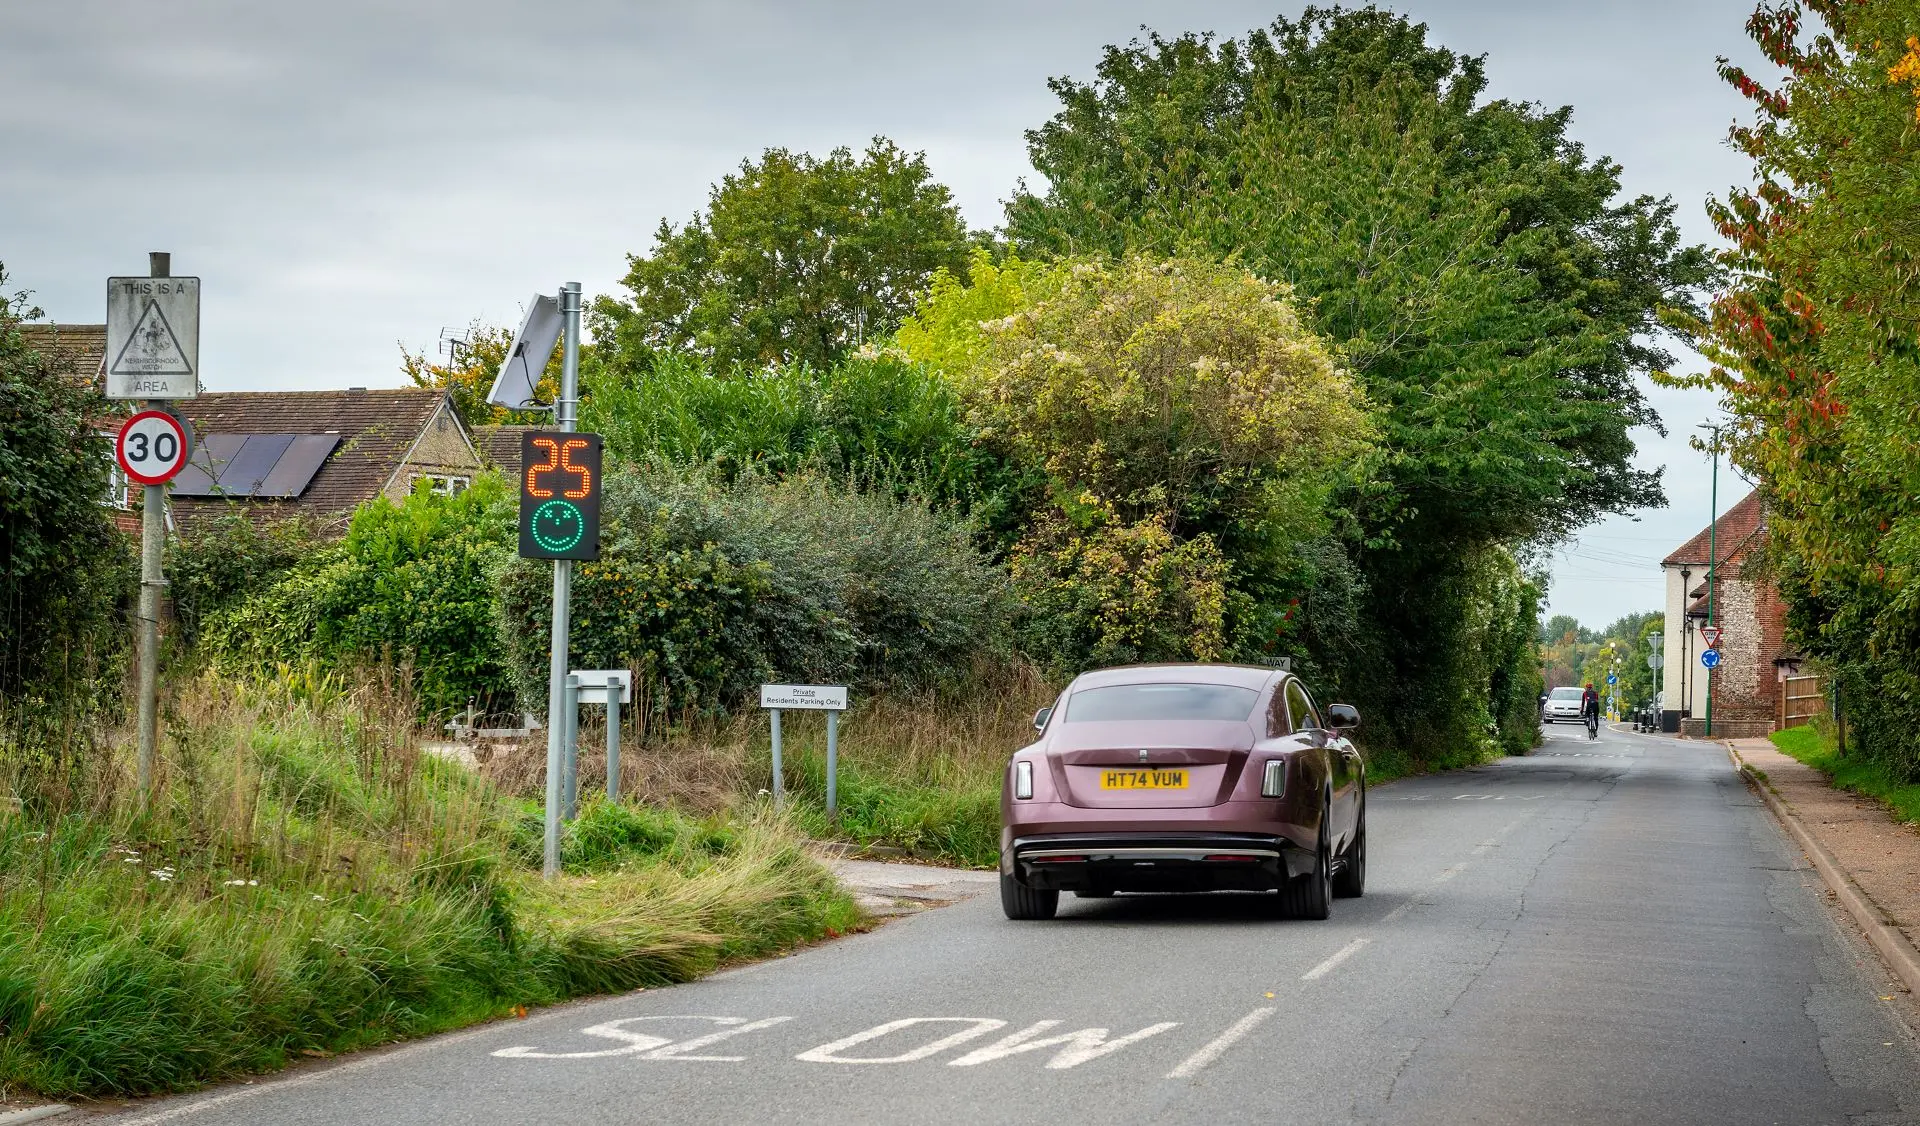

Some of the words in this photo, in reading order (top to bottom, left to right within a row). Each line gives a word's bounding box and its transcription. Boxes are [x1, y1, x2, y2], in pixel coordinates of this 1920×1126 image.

[123, 283, 152, 295] THIS
[158, 283, 170, 295] IS
[176, 283, 185, 295] A
[134, 381, 169, 392] AREA
[128, 432, 177, 462] 30
[527, 438, 591, 498] 25
[1267, 659, 1286, 667] WAY
[800, 698, 824, 706] Parking
[1107, 772, 1148, 787] HT74
[1152, 772, 1182, 786] VUM
[490, 1015, 1184, 1069] SLOW
